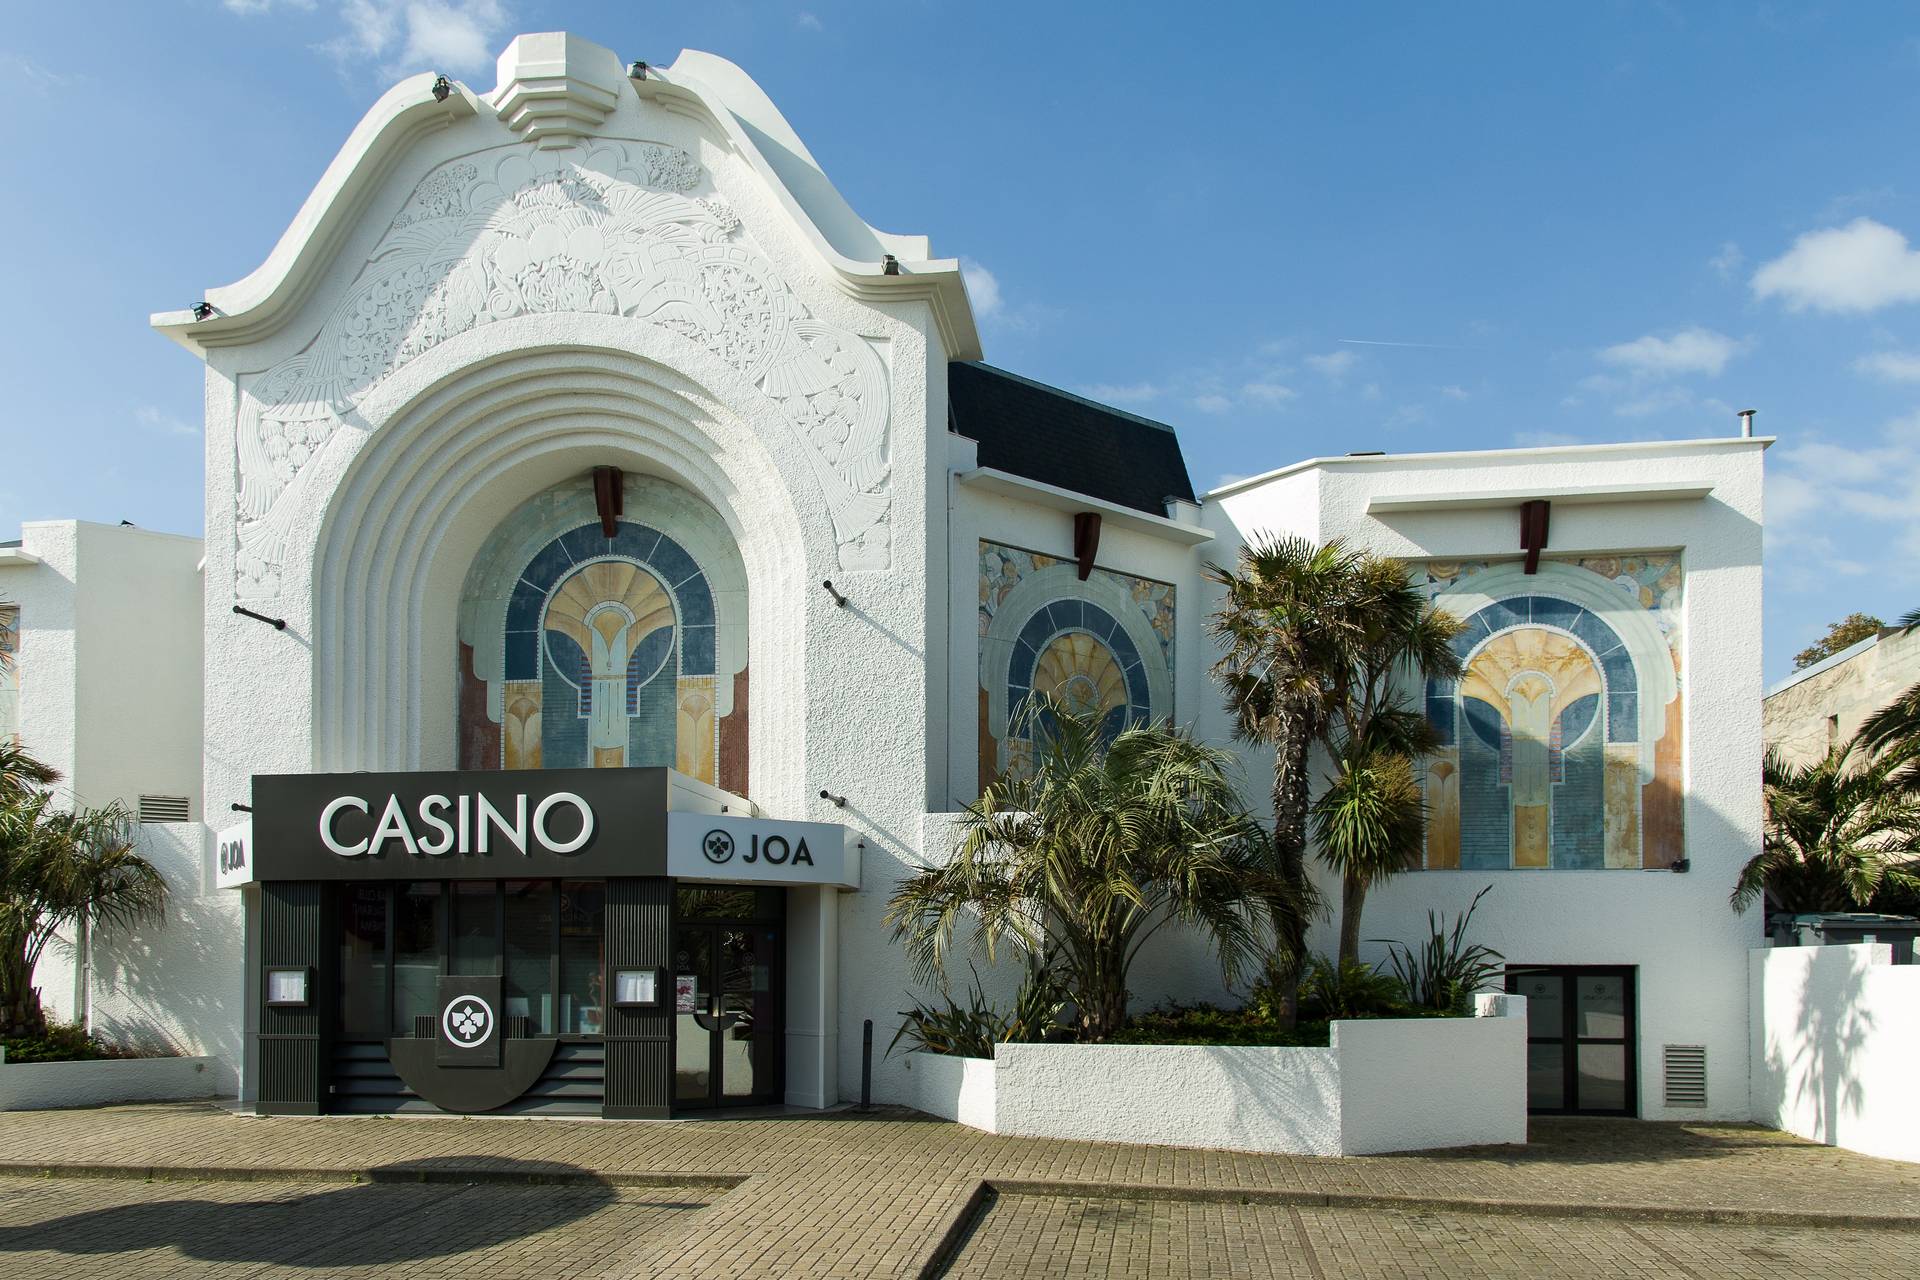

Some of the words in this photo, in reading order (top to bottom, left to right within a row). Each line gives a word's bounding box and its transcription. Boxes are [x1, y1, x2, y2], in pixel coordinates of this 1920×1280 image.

[319, 792, 594, 857] CASINO
[228, 839, 246, 871] JOA
[742, 834, 814, 866] JOA
